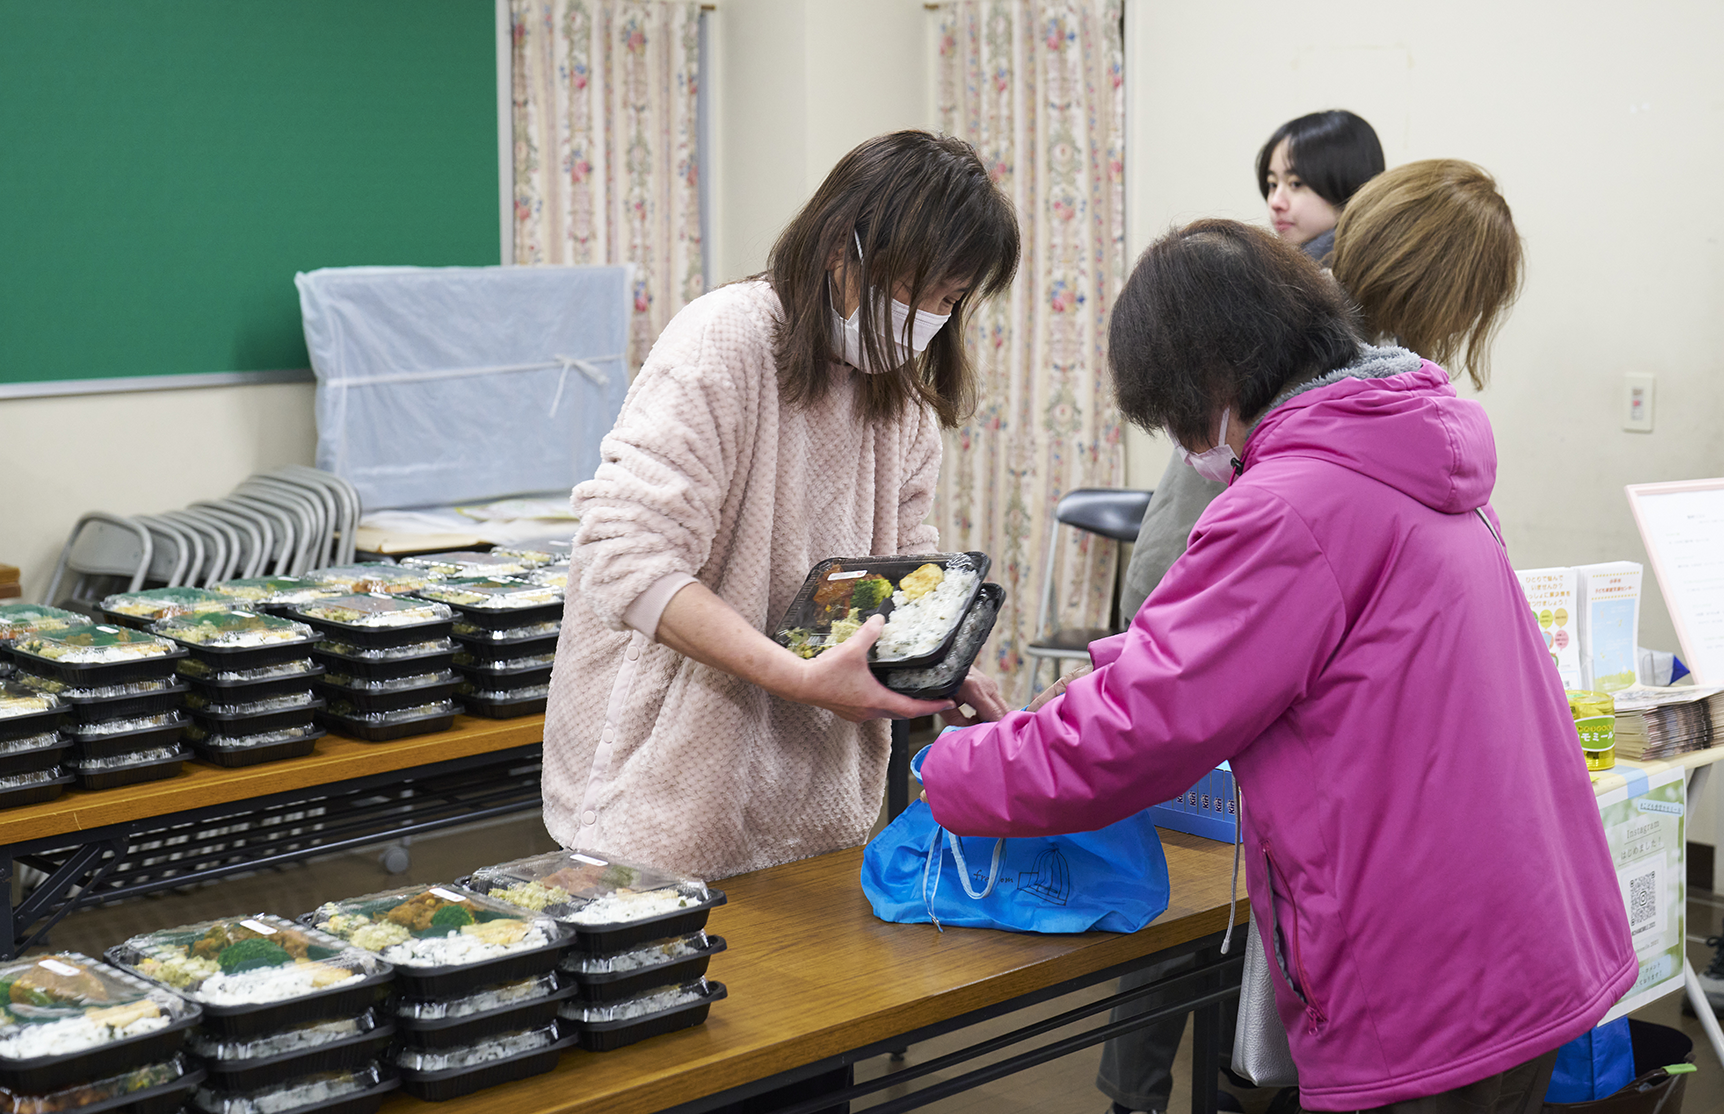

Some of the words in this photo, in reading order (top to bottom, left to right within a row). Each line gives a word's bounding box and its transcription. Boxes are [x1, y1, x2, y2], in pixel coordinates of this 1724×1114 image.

[1577, 731, 1614, 742] モミール
[1627, 821, 1660, 839] Instagram
[1621, 836, 1662, 860] はじめました！
[973, 869, 1013, 883] freom
